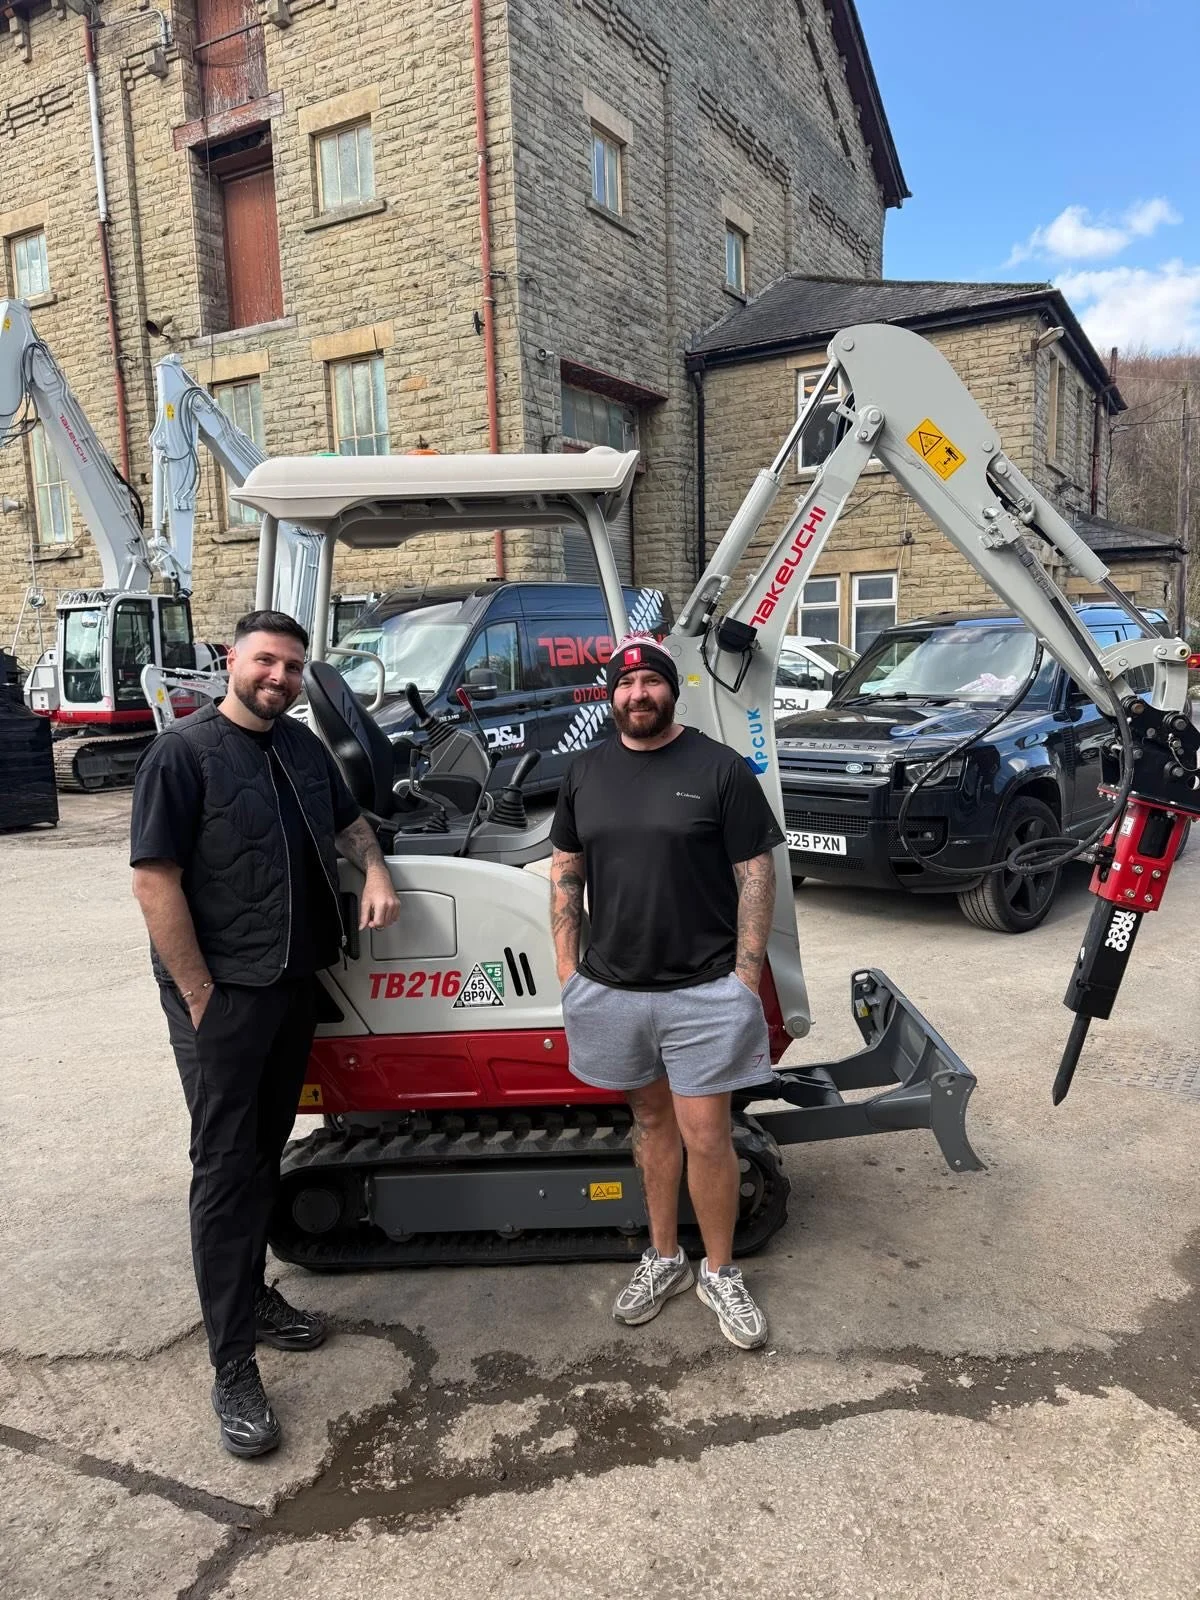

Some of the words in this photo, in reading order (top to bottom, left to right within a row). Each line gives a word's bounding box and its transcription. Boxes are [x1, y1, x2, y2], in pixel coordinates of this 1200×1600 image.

[60, 413, 87, 463] TAKEUCHI
[749, 506, 826, 627] TAKEUCHI
[573, 686, 608, 703] 01706
[773, 698, 809, 710] D&J
[483, 723, 525, 749] D&J
[775, 740, 877, 750] EFENDER
[813, 835, 841, 852] PXN
[369, 970, 462, 999] TB216
[471, 979, 485, 991] 65
[463, 990, 492, 1002] BP9V
